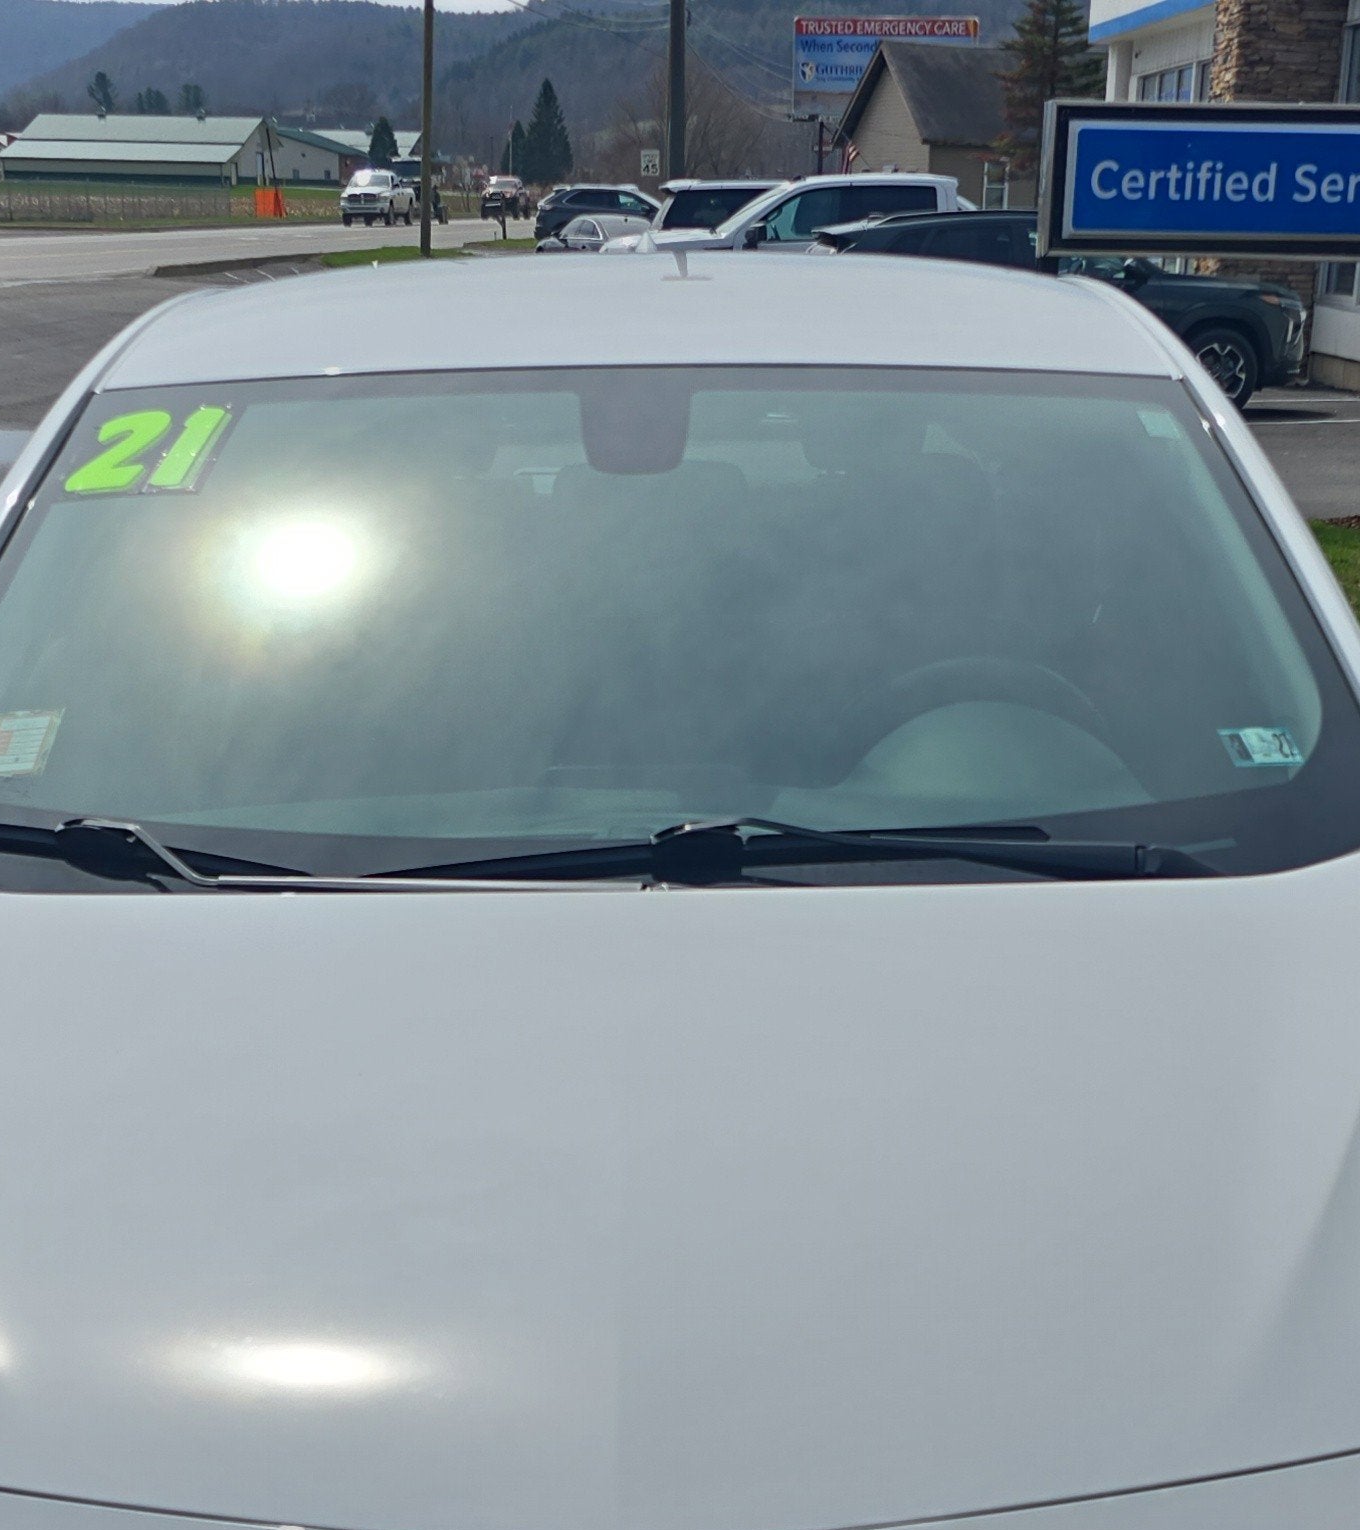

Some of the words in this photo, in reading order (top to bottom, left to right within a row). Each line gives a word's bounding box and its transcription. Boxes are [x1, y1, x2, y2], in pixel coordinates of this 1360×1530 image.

[801, 20, 854, 35] TRUSTED
[856, 20, 932, 35] EMERGENCY
[934, 21, 966, 36] CARE
[800, 39, 834, 53] When
[642, 163, 659, 175] 45
[1090, 159, 1278, 202] Certified
[64, 406, 233, 493] 21
